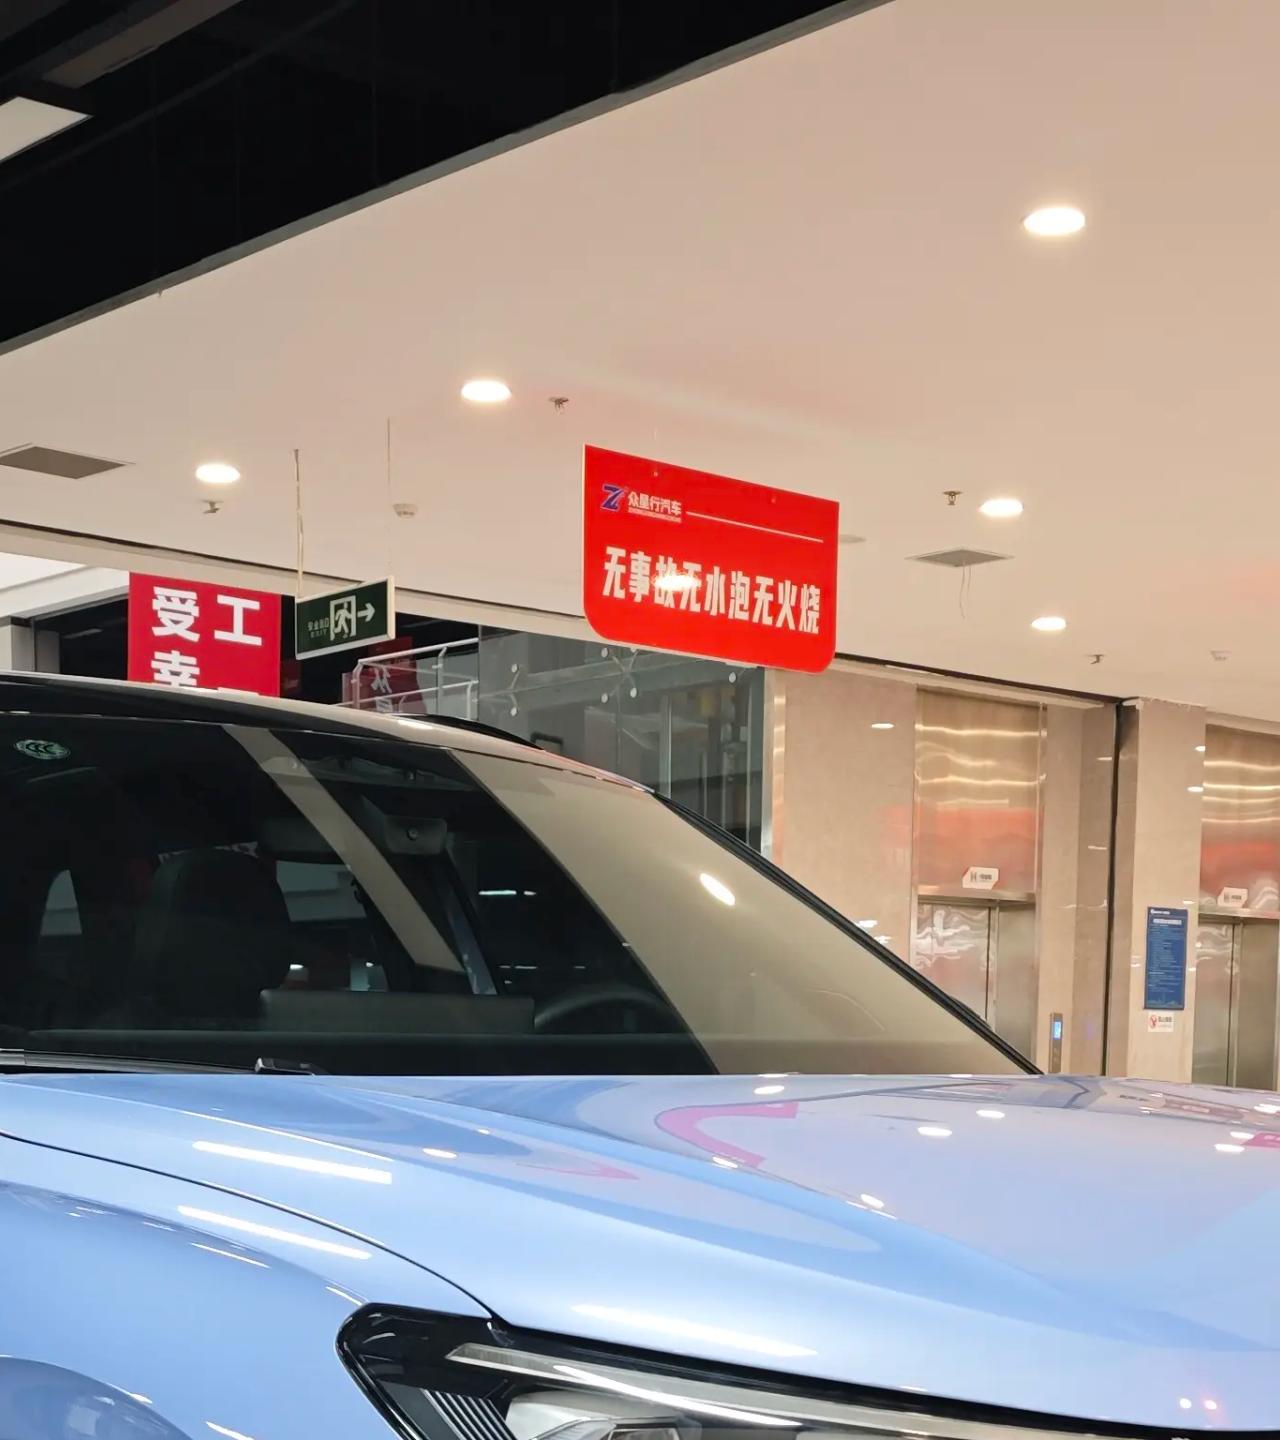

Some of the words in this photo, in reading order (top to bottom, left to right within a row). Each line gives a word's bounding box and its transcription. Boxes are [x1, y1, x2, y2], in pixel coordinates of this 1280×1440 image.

[627, 491, 682, 516] 众星行汽车
[601, 545, 822, 635] 无事故无水泡无火烧
